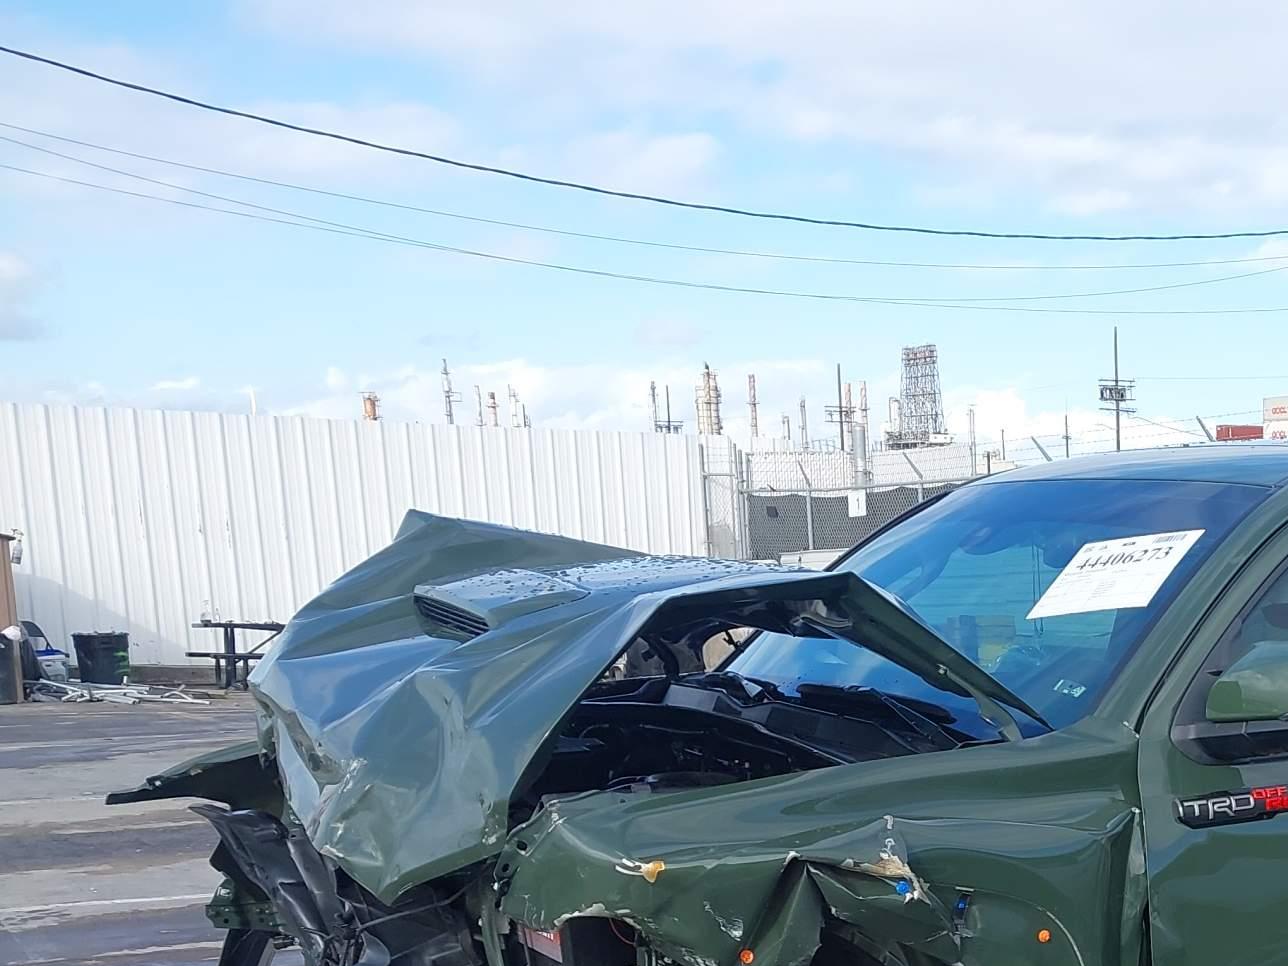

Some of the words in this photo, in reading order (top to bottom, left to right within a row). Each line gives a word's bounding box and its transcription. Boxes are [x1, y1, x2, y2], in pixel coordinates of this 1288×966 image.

[1076, 546, 1174, 570] 44406273
[1182, 794, 1255, 820] TRD
[1252, 786, 1288, 799] OFF
